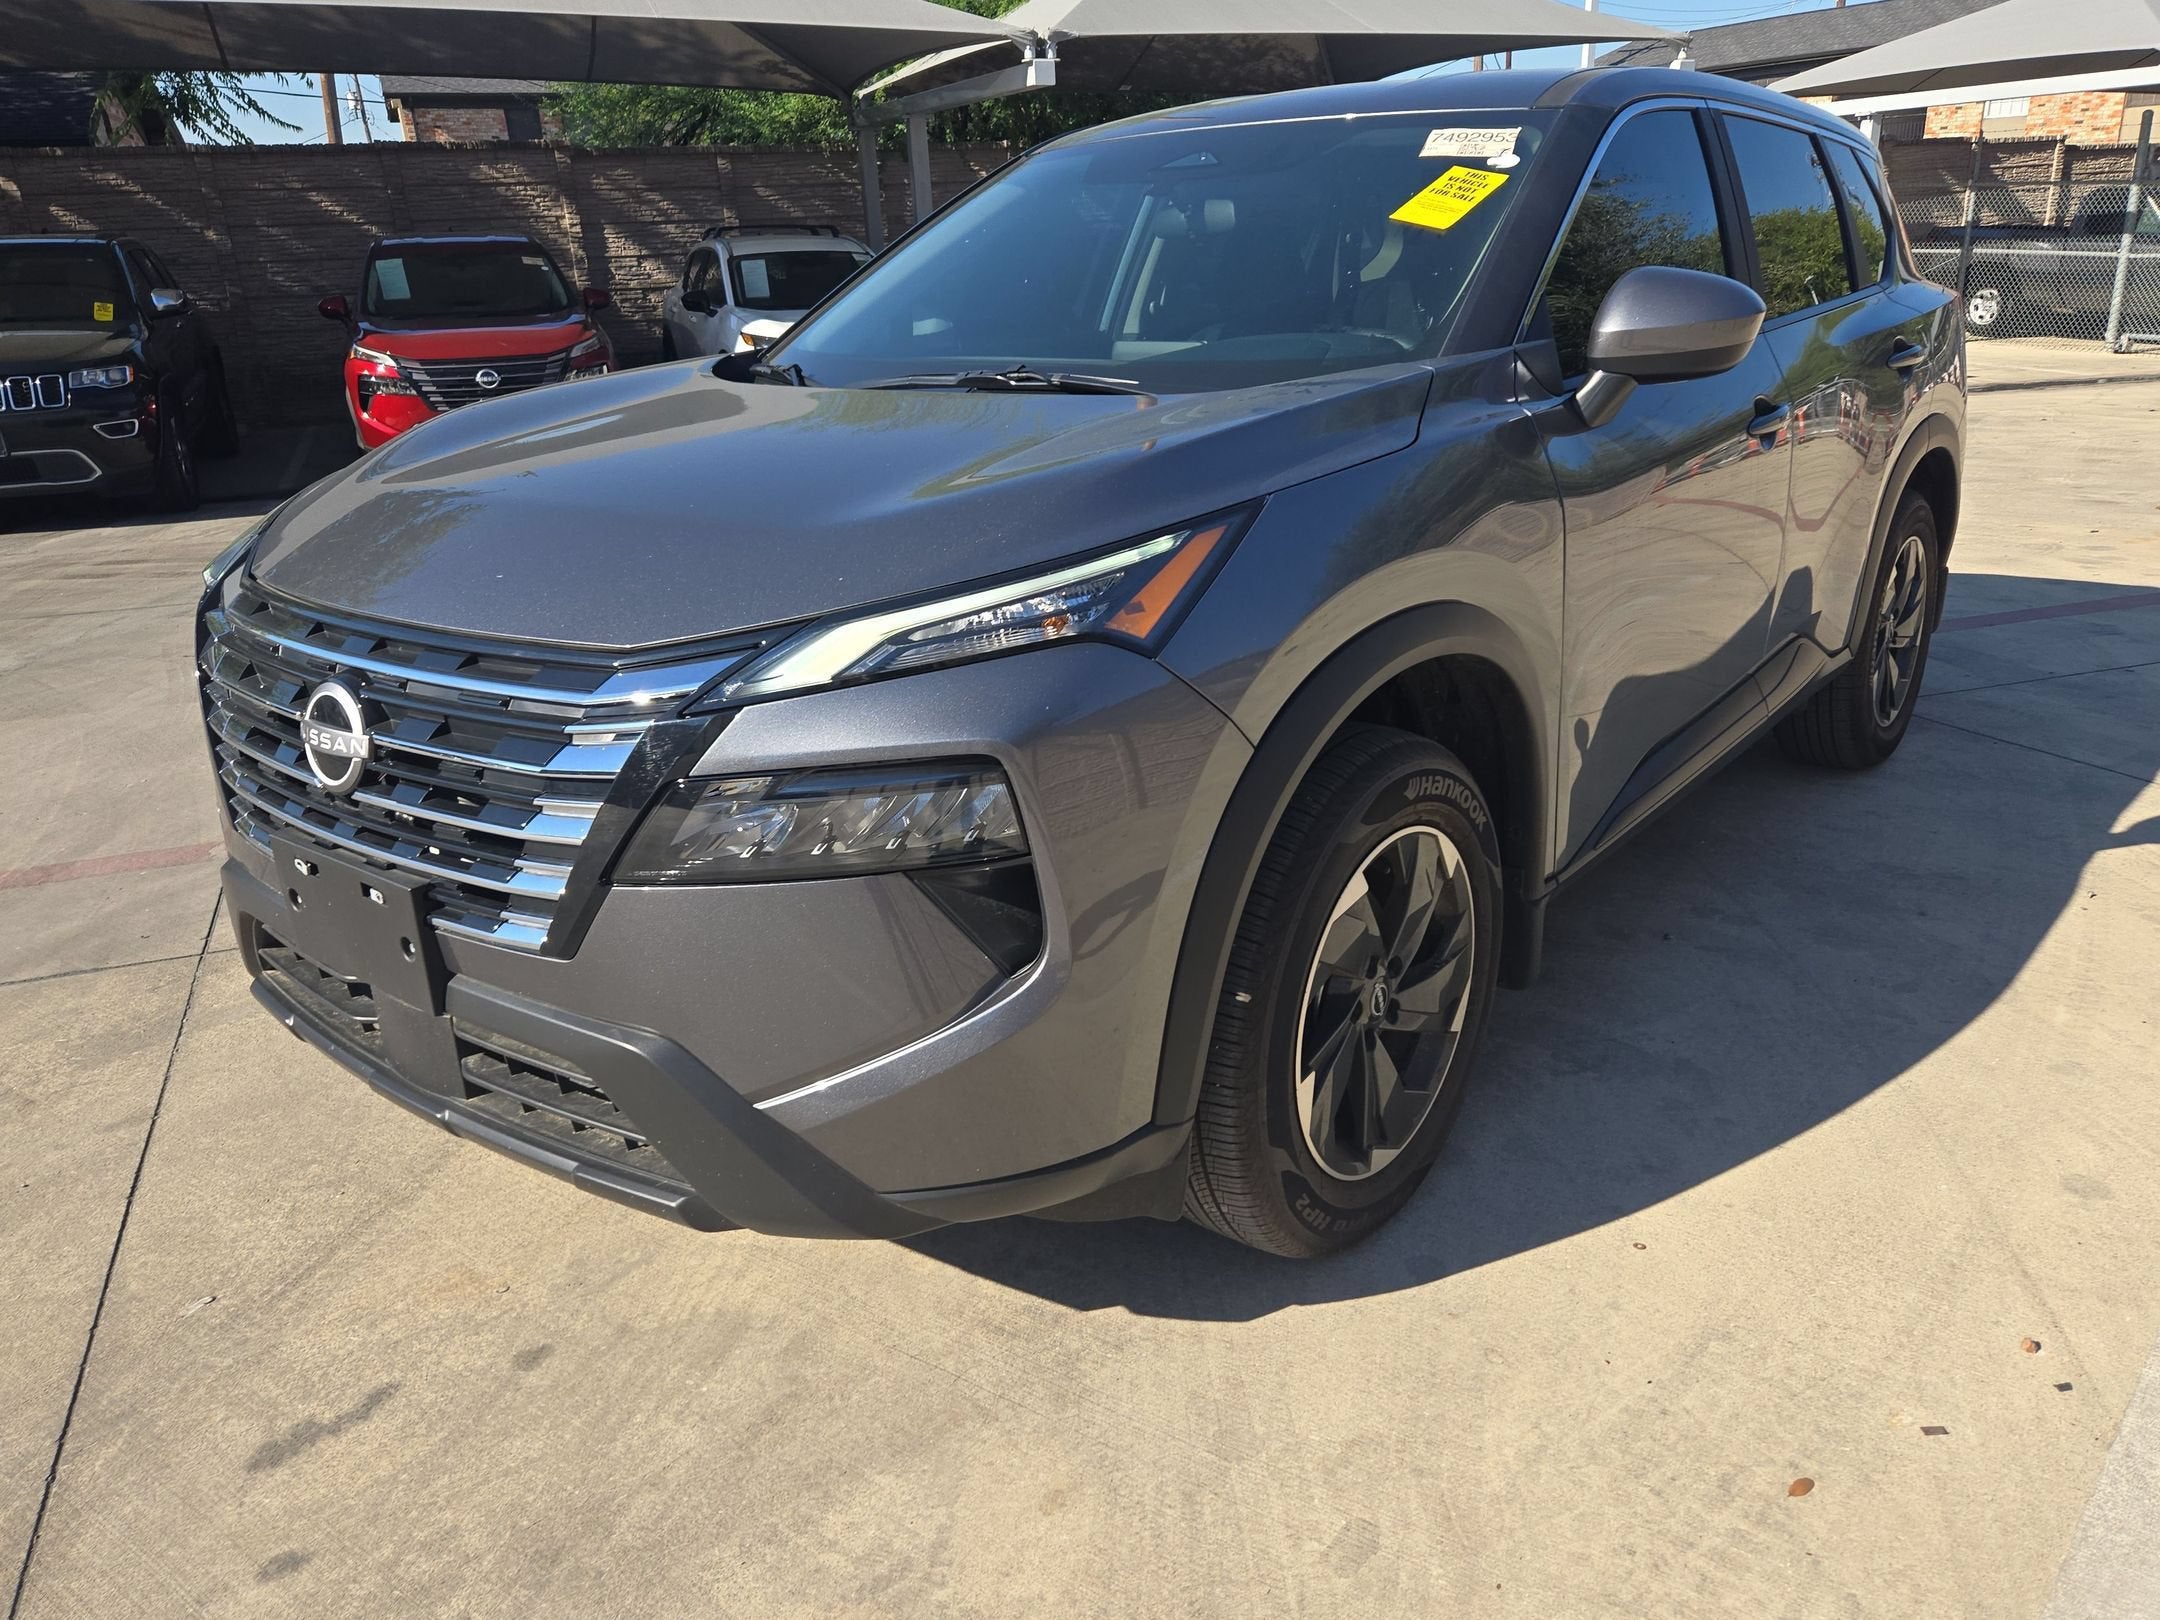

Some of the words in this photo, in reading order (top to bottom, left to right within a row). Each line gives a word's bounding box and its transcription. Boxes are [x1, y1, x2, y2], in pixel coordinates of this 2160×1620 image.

[1464, 171, 1489, 181] THIS
[1428, 187, 1450, 196] FOR
[1450, 191, 1475, 202] SALE
[1456, 185, 1478, 194] NOT
